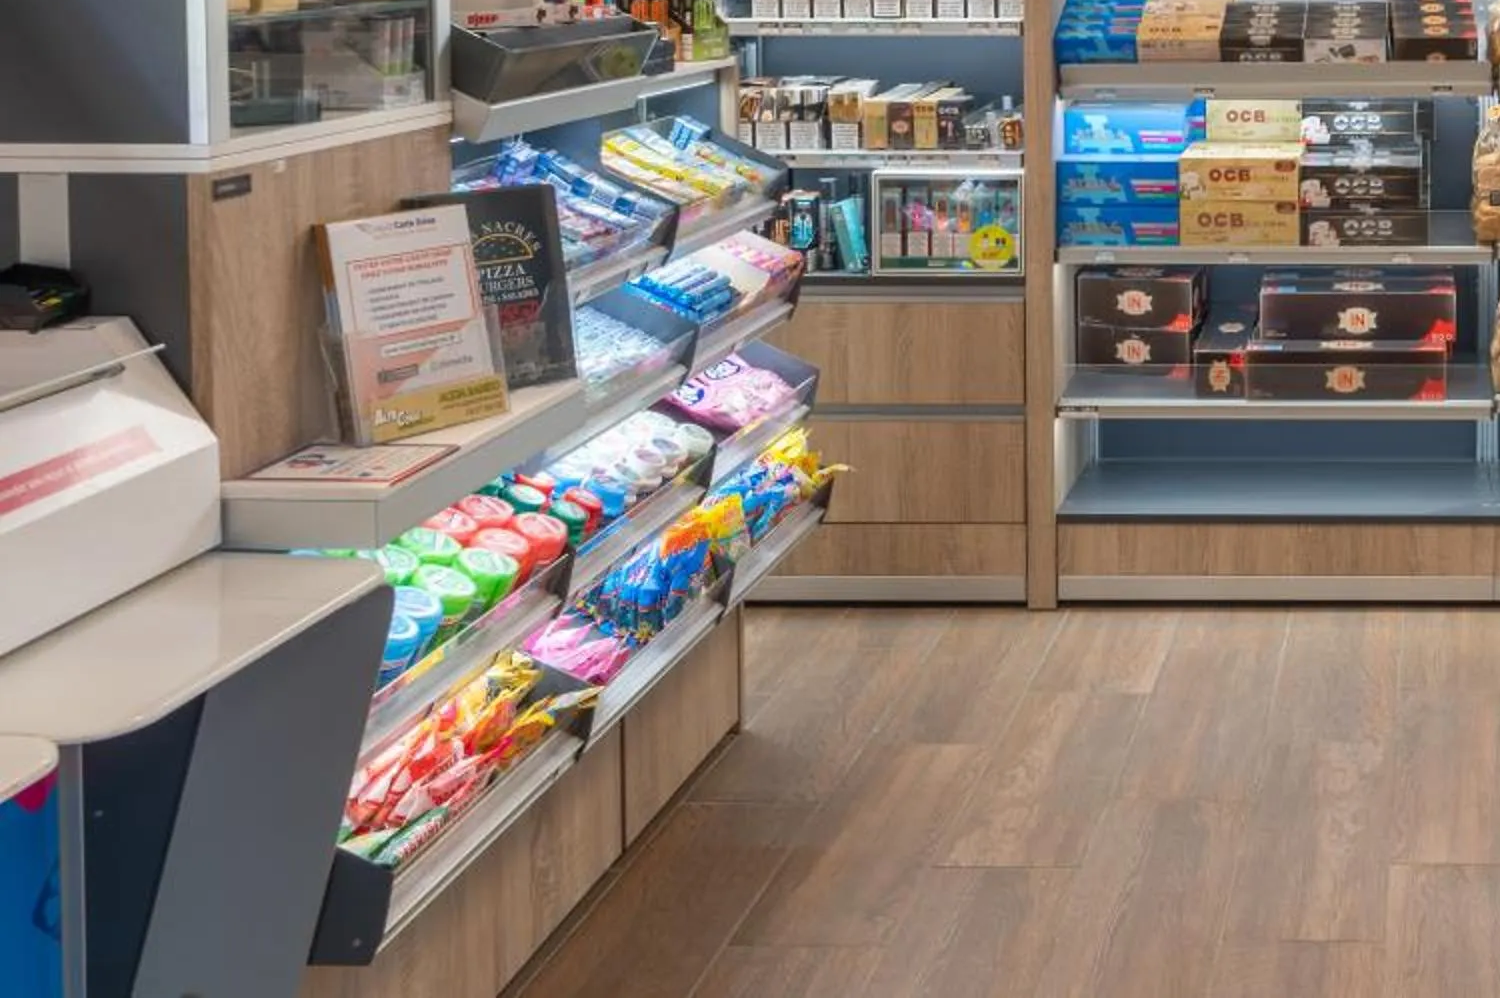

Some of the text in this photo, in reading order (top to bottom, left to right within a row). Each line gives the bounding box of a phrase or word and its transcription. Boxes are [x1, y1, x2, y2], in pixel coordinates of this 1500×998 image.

[1226, 110, 1265, 123] OCB
[1333, 114, 1382, 131] OCB
[1209, 168, 1251, 182] OCB
[1335, 177, 1385, 195] OCB
[1197, 212, 1244, 228] OCB
[1343, 219, 1393, 236] OCB
